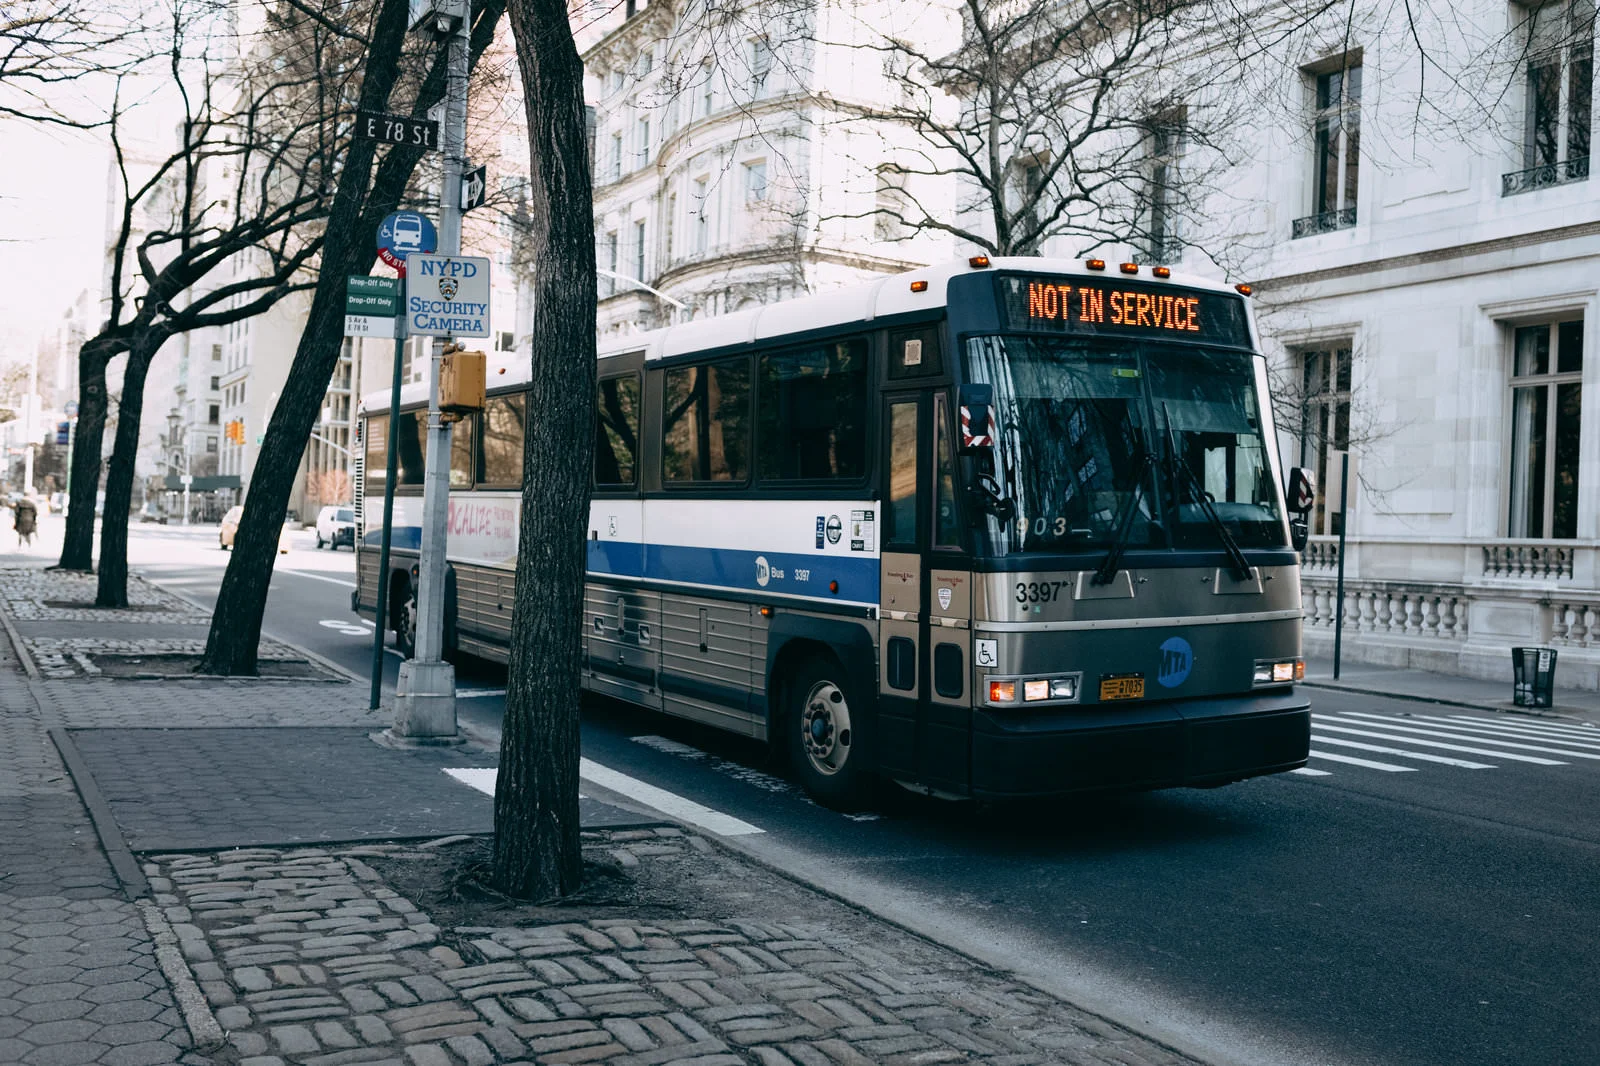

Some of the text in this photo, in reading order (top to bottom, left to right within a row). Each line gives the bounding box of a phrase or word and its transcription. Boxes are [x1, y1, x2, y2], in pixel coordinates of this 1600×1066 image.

[367, 118, 430, 146] E 78 St
[382, 250, 393, 261] NO
[420, 260, 477, 278] NYPD
[350, 278, 393, 289] Drop-Off Only
[348, 296, 392, 307] Drop-Off Only
[410, 296, 487, 316] SECURITY
[1029, 282, 1199, 331] NOT IN SERVICE
[414, 313, 484, 332] CAMERA
[771, 566, 784, 579] Bus
[794, 568, 810, 581] 3397
[1015, 582, 1061, 603] 3397
